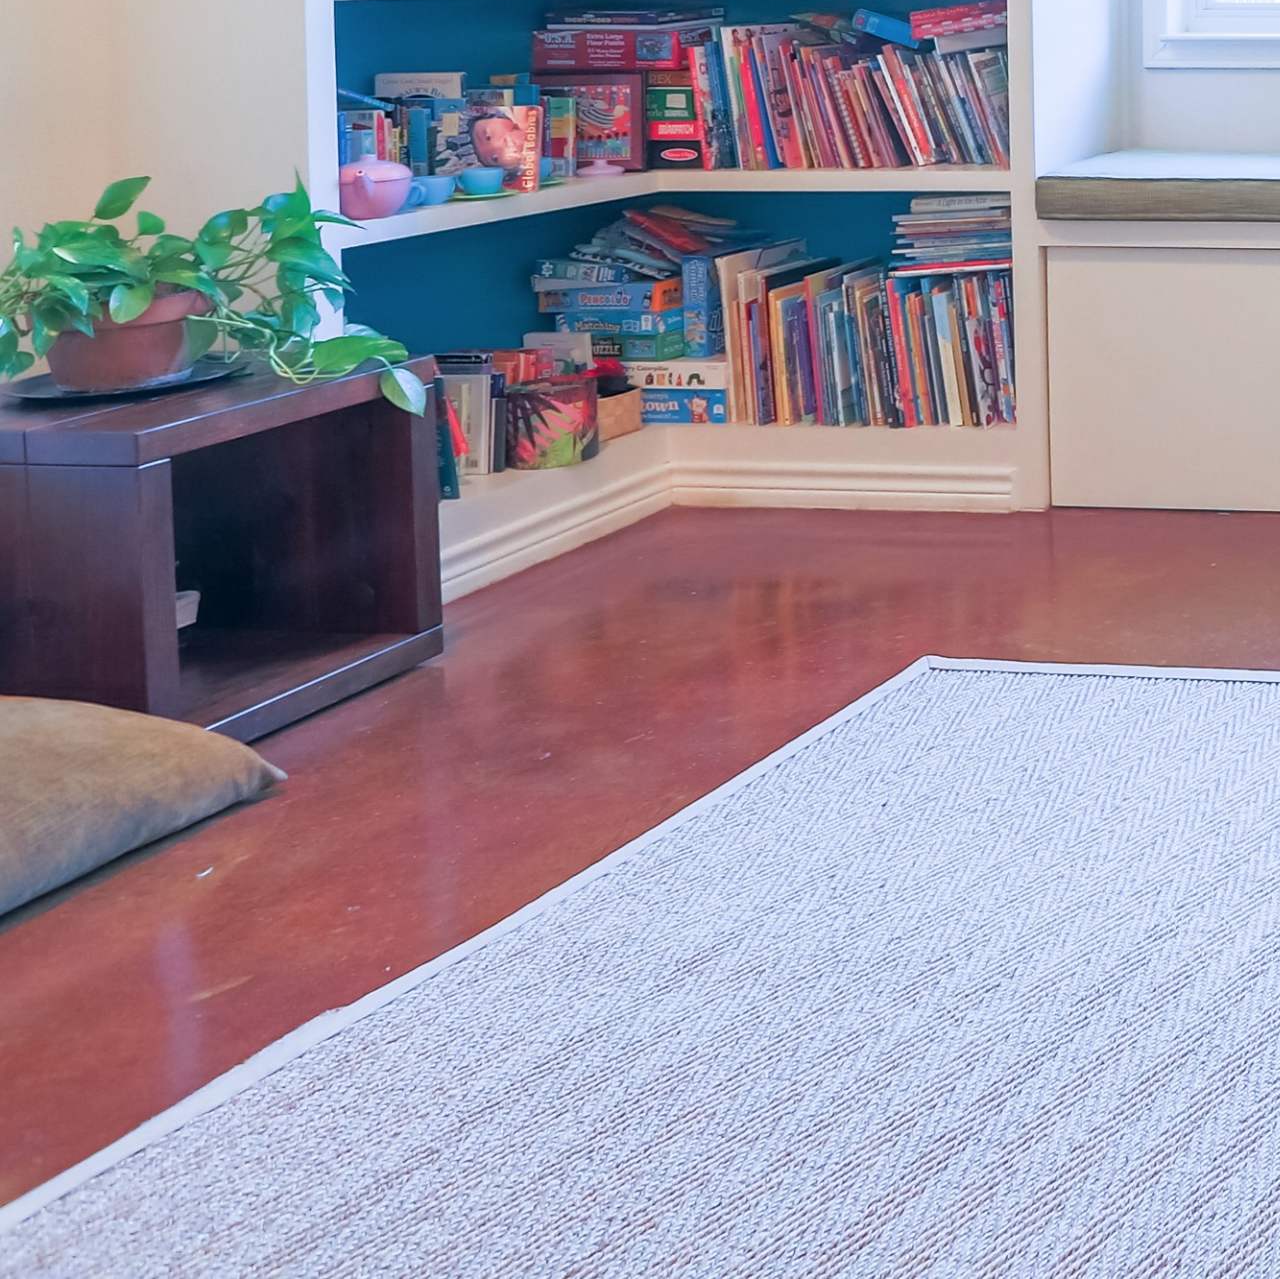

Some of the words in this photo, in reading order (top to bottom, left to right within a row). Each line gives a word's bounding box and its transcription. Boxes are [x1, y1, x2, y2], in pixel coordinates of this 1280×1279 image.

[606, 33, 624, 41] Large
[525, 108, 537, 148] Babies
[521, 149, 537, 188] Global
